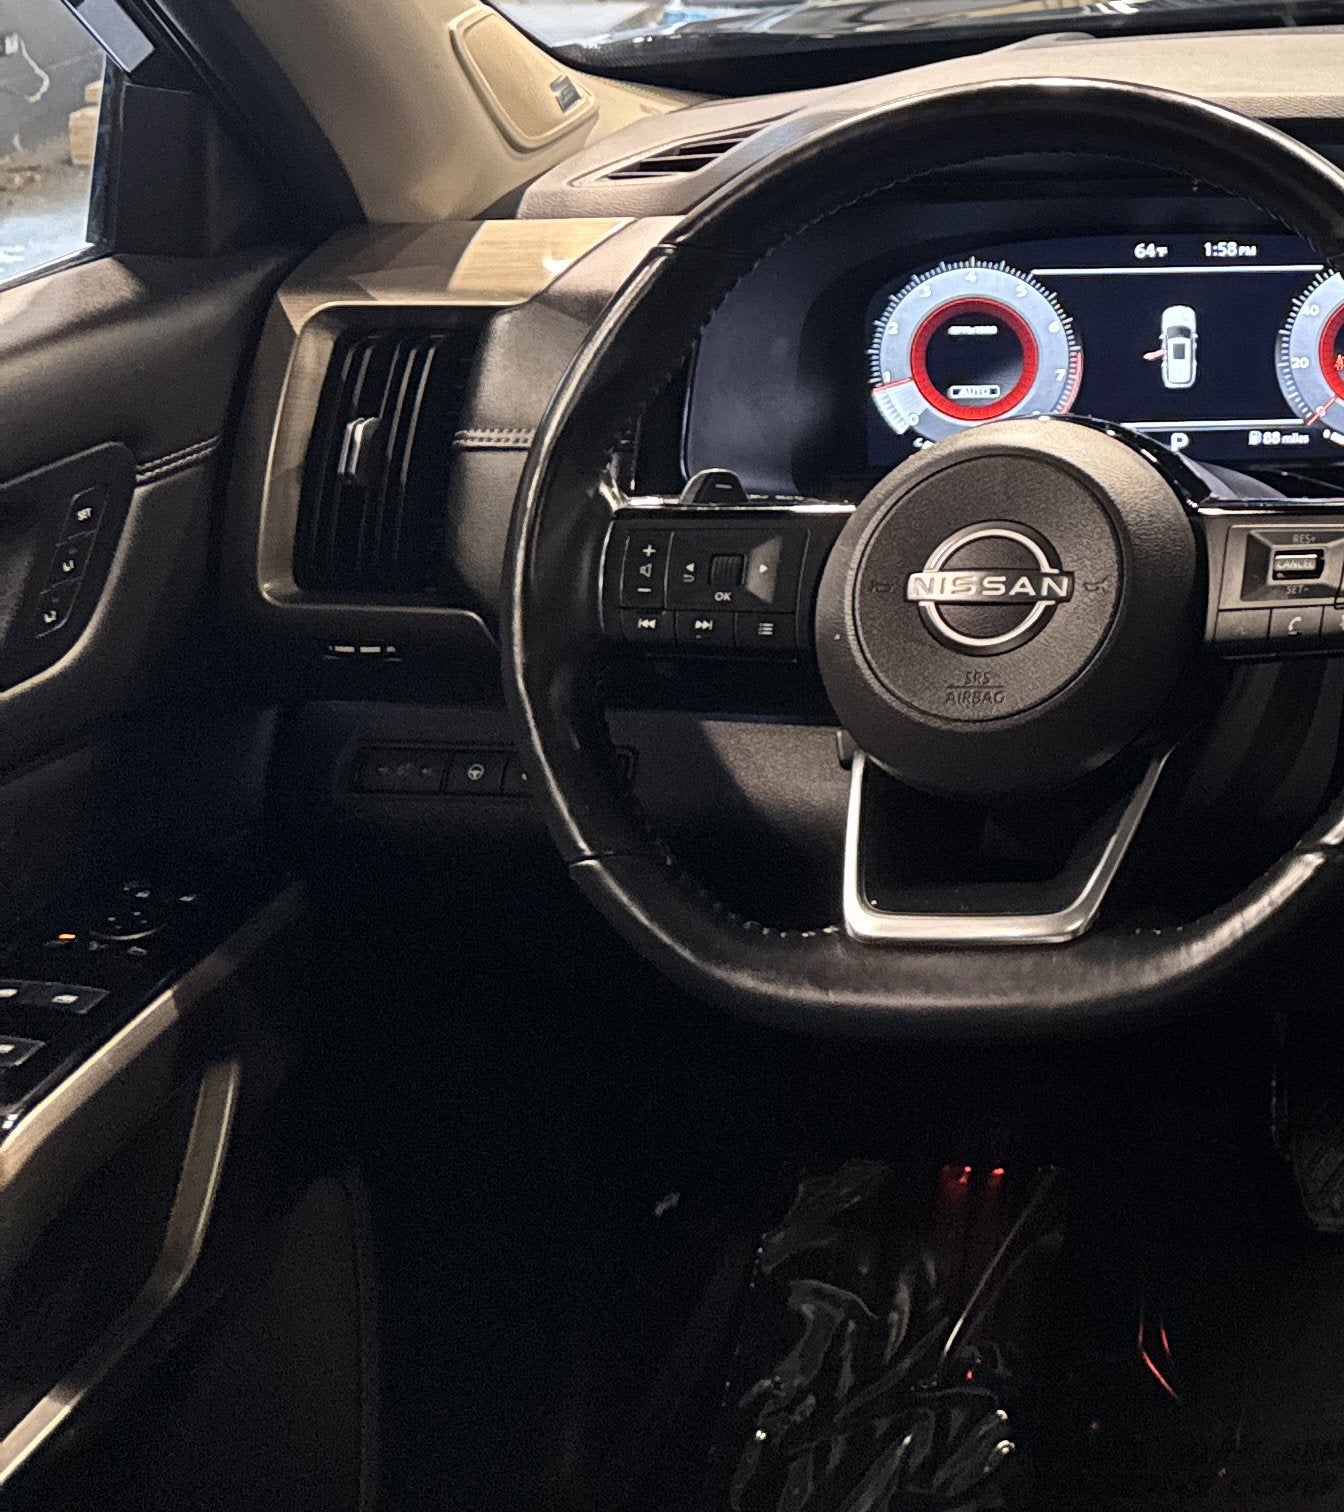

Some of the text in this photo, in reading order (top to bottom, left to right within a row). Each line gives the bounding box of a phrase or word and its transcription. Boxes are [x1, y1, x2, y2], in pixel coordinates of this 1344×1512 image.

[888, 322, 899, 335] 2
[1291, 356, 1310, 369] 20
[1055, 369, 1068, 381] 7
[1170, 432, 1190, 451] P
[1281, 431, 1310, 445] miles
[913, 575, 1069, 597] NISSAN
[714, 591, 733, 601] OK
[965, 671, 990, 685] SRS
[945, 690, 1006, 706] AIRBAG
